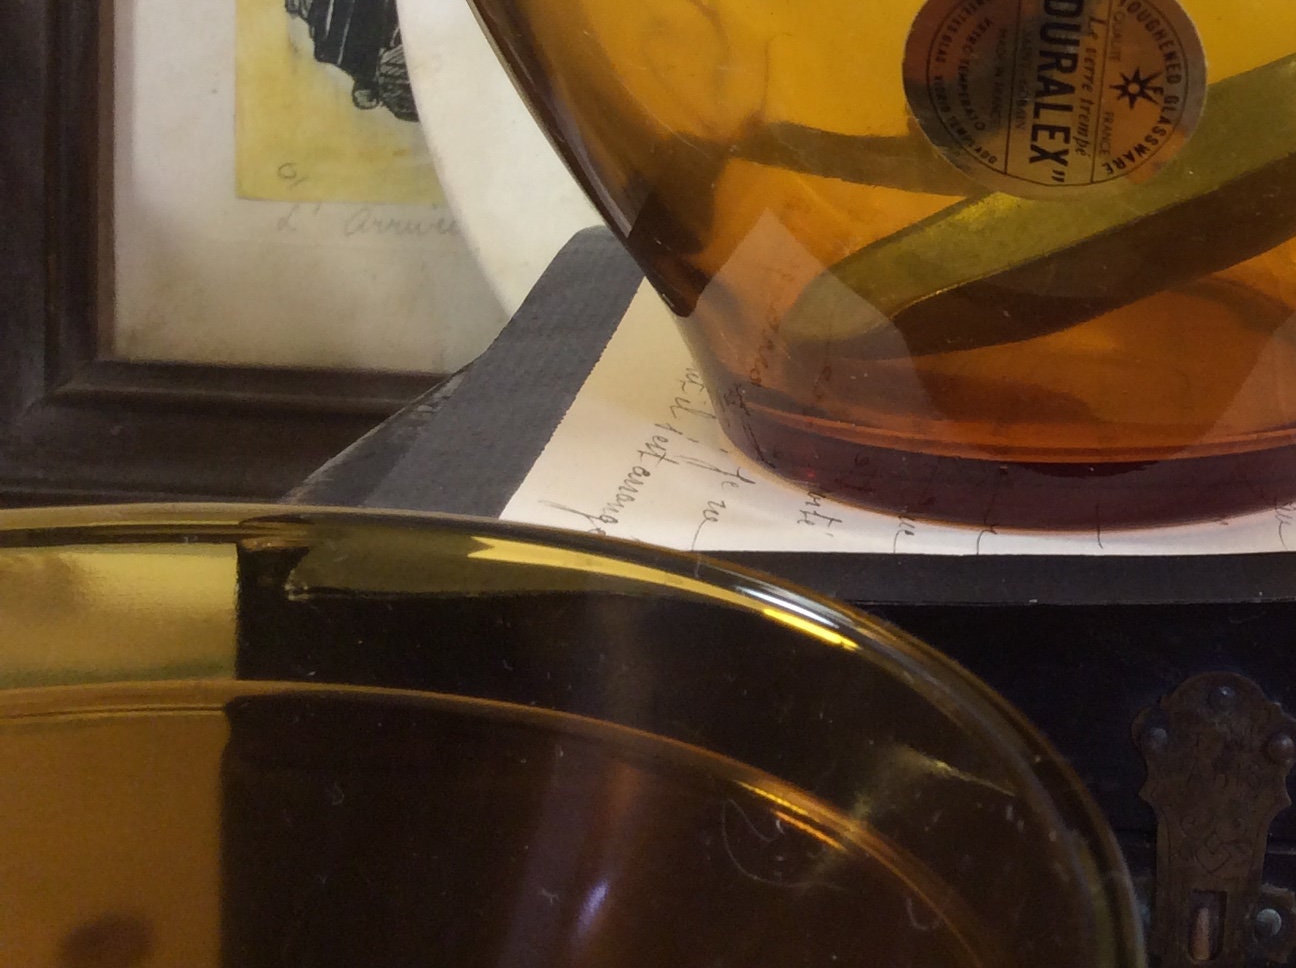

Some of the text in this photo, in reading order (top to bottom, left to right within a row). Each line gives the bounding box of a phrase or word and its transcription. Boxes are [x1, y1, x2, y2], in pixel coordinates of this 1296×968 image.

[957, 58, 986, 132] TEMPERATO
[1075, 15, 1110, 158] Le verre trempé
[1098, 111, 1115, 156] FRANCE
[1105, 92, 1181, 175] GLASSWARE
